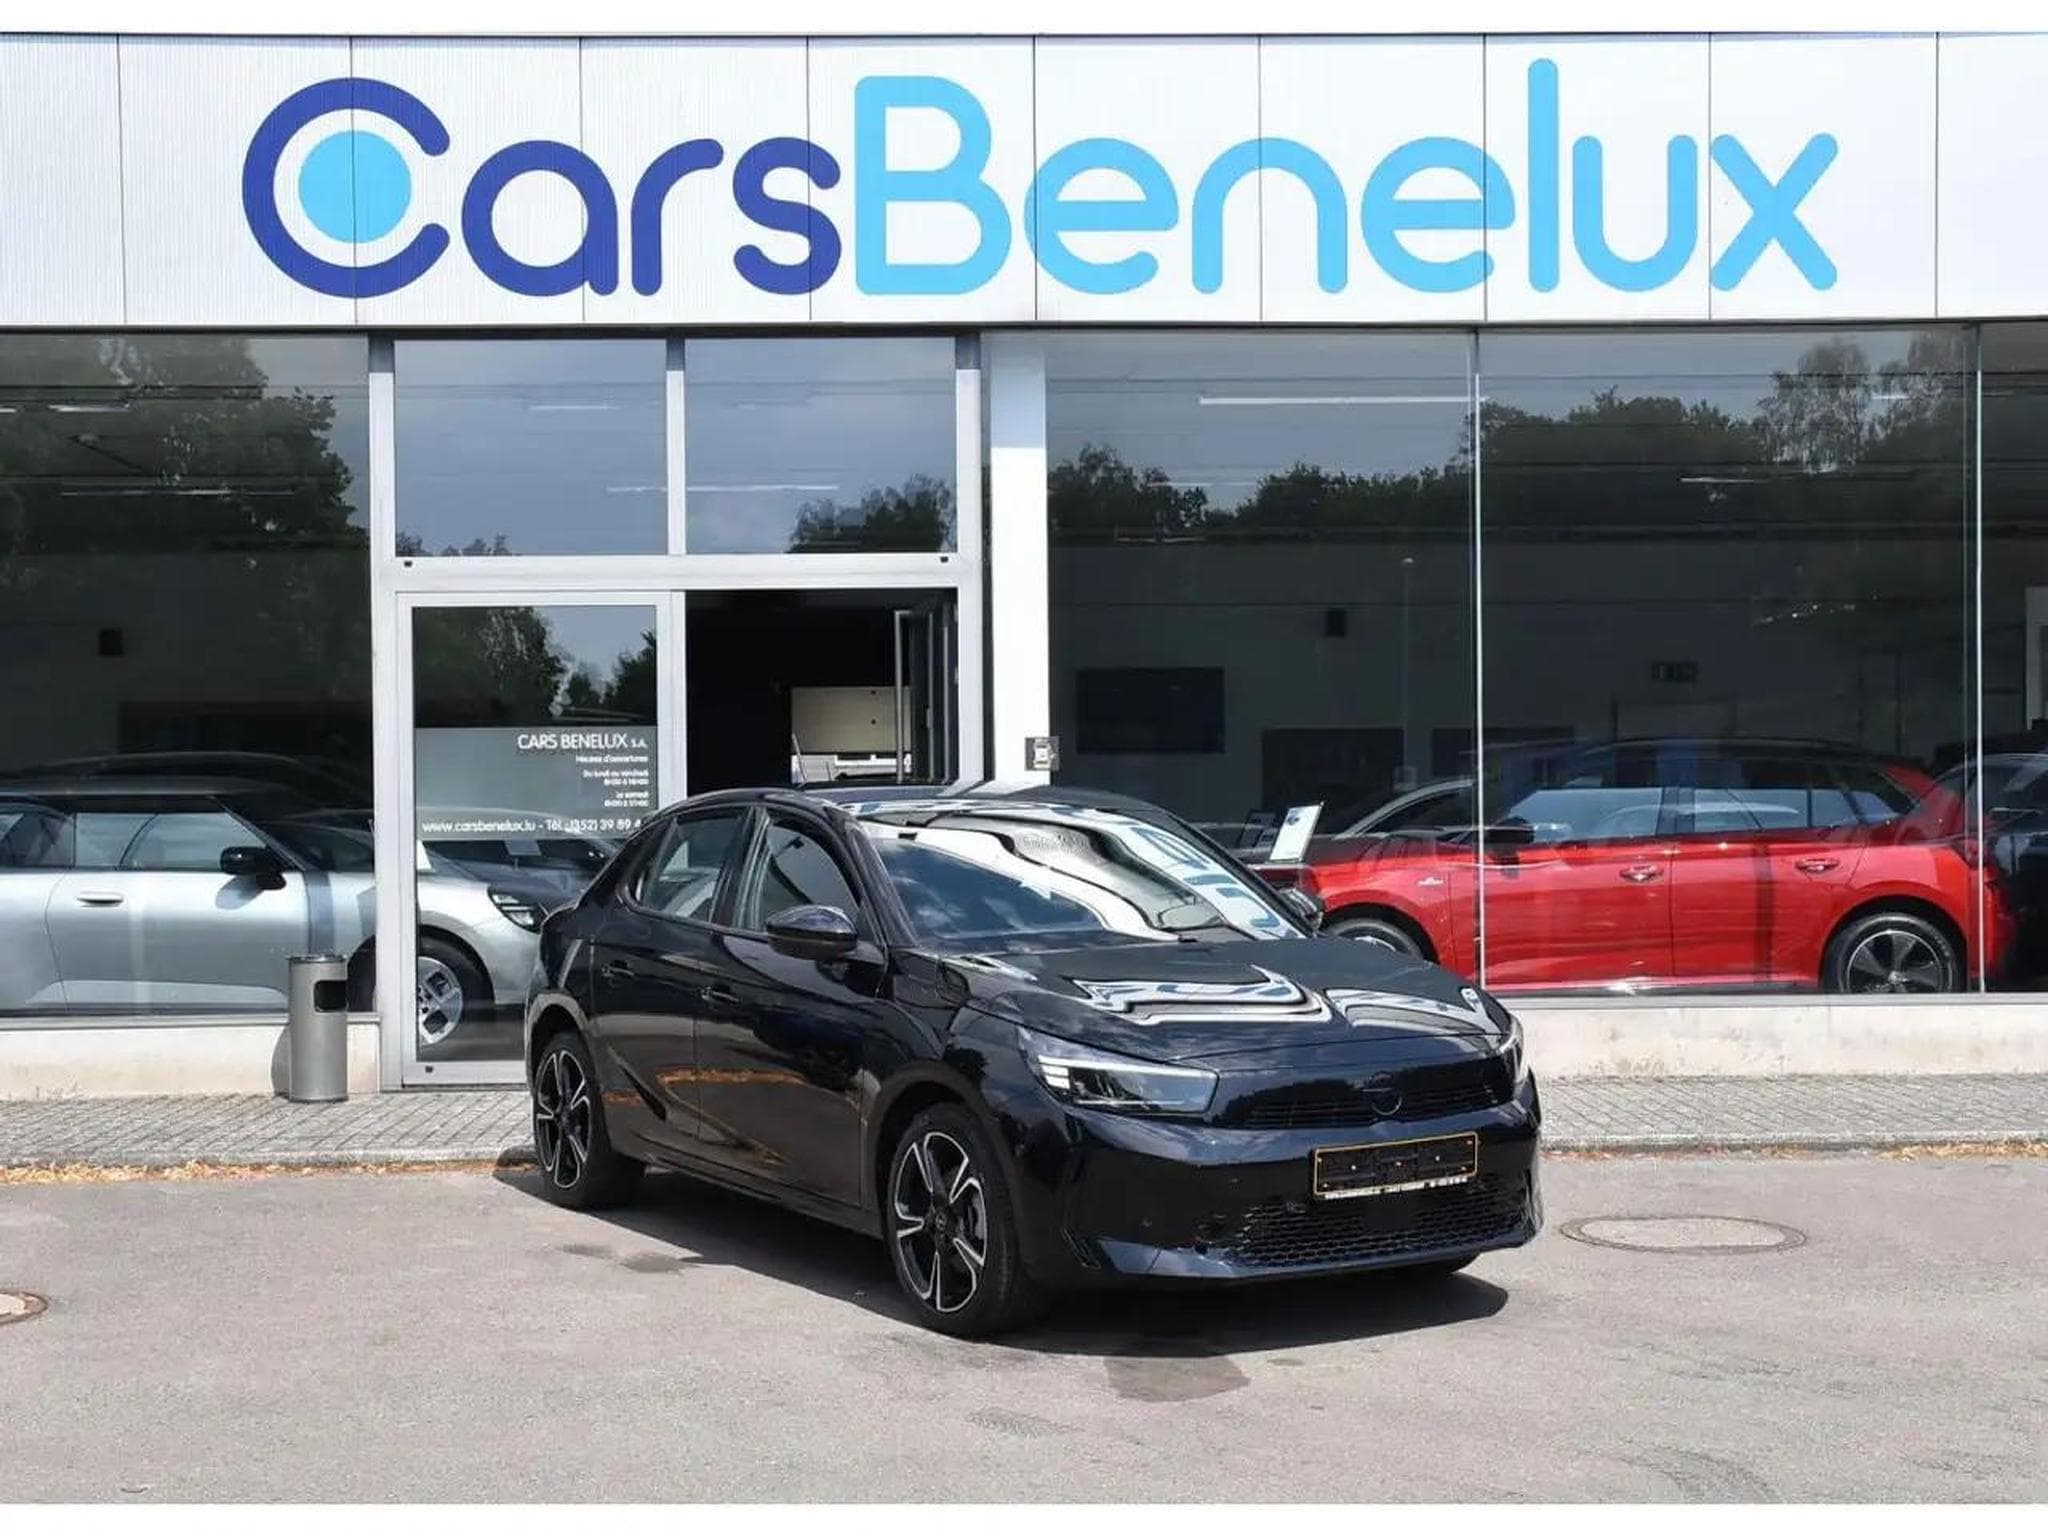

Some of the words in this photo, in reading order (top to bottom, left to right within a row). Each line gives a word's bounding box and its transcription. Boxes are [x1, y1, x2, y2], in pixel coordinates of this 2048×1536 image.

[518, 734, 557, 749] CARS
[561, 734, 628, 749] BENELUX
[422, 819, 536, 832] www.carsbenelux.lu
[600, 819, 614, 831] 39
